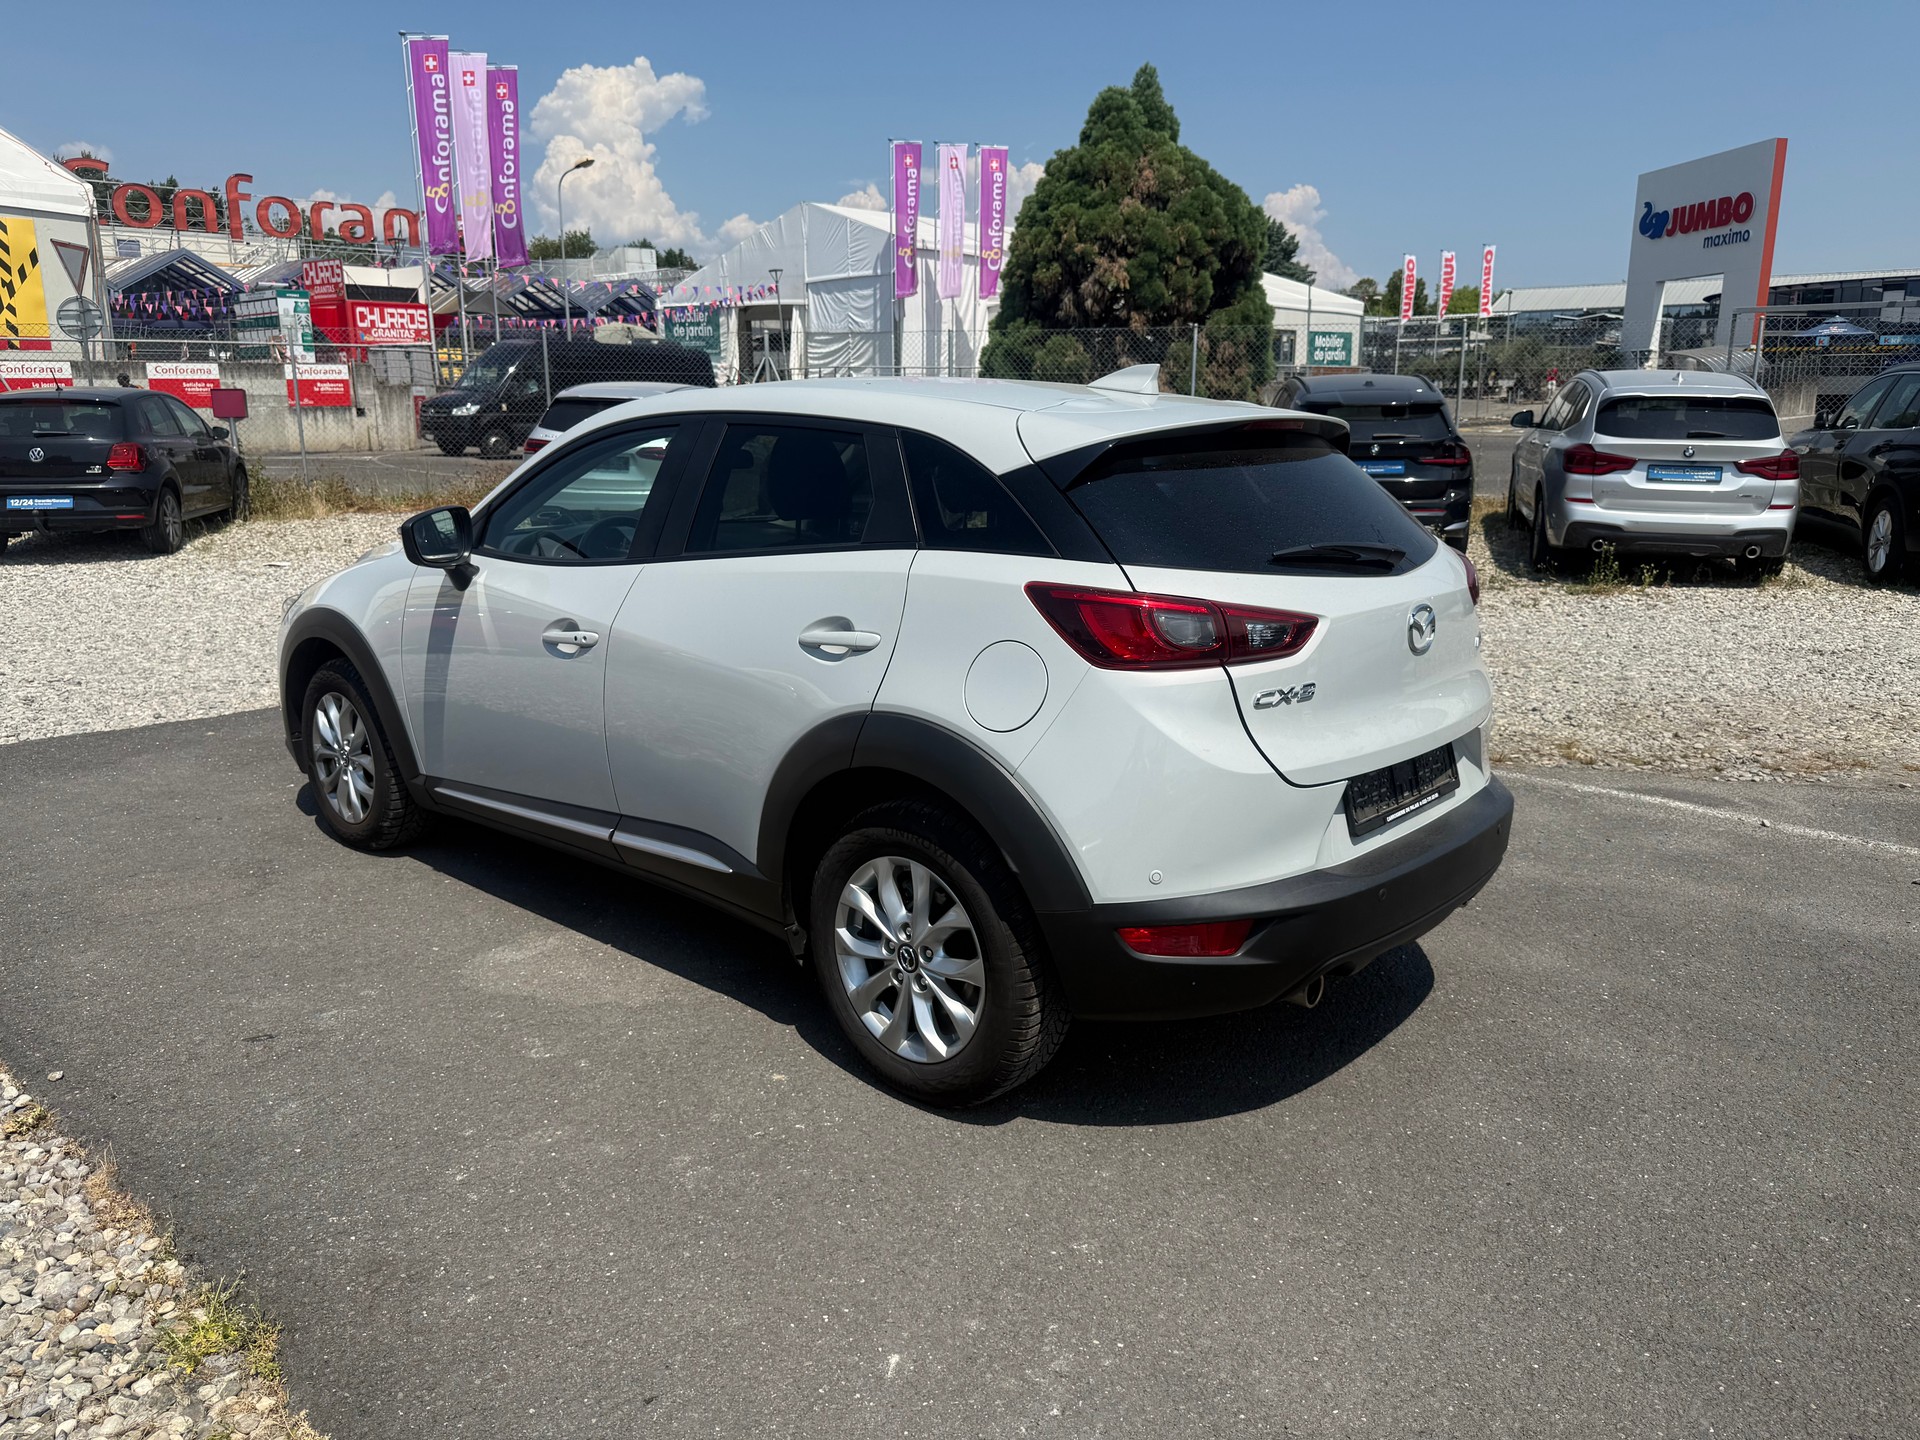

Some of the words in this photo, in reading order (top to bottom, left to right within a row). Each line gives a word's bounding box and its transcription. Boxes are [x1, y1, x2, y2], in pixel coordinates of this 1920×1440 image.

[61, 157, 425, 248] onforam
[1666, 192, 1755, 237] JUMBO
[1703, 228, 1750, 249] maximo
[303, 259, 342, 285] CHURROS
[314, 284, 335, 294] GRANITAS
[1481, 249, 1493, 316] JUMBO
[356, 306, 428, 329] CHURROS
[371, 328, 416, 338] GRANITAS
[674, 324, 685, 337] de
[686, 323, 713, 340] jardin
[1315, 335, 1344, 347] Mobilier
[1314, 348, 1324, 361] de
[1324, 348, 1346, 364] jardin
[154, 365, 212, 375] Conforama
[296, 367, 343, 377] onforama
[10, 498, 34, 507] 12/24
[1253, 680, 1317, 711] CX-3
